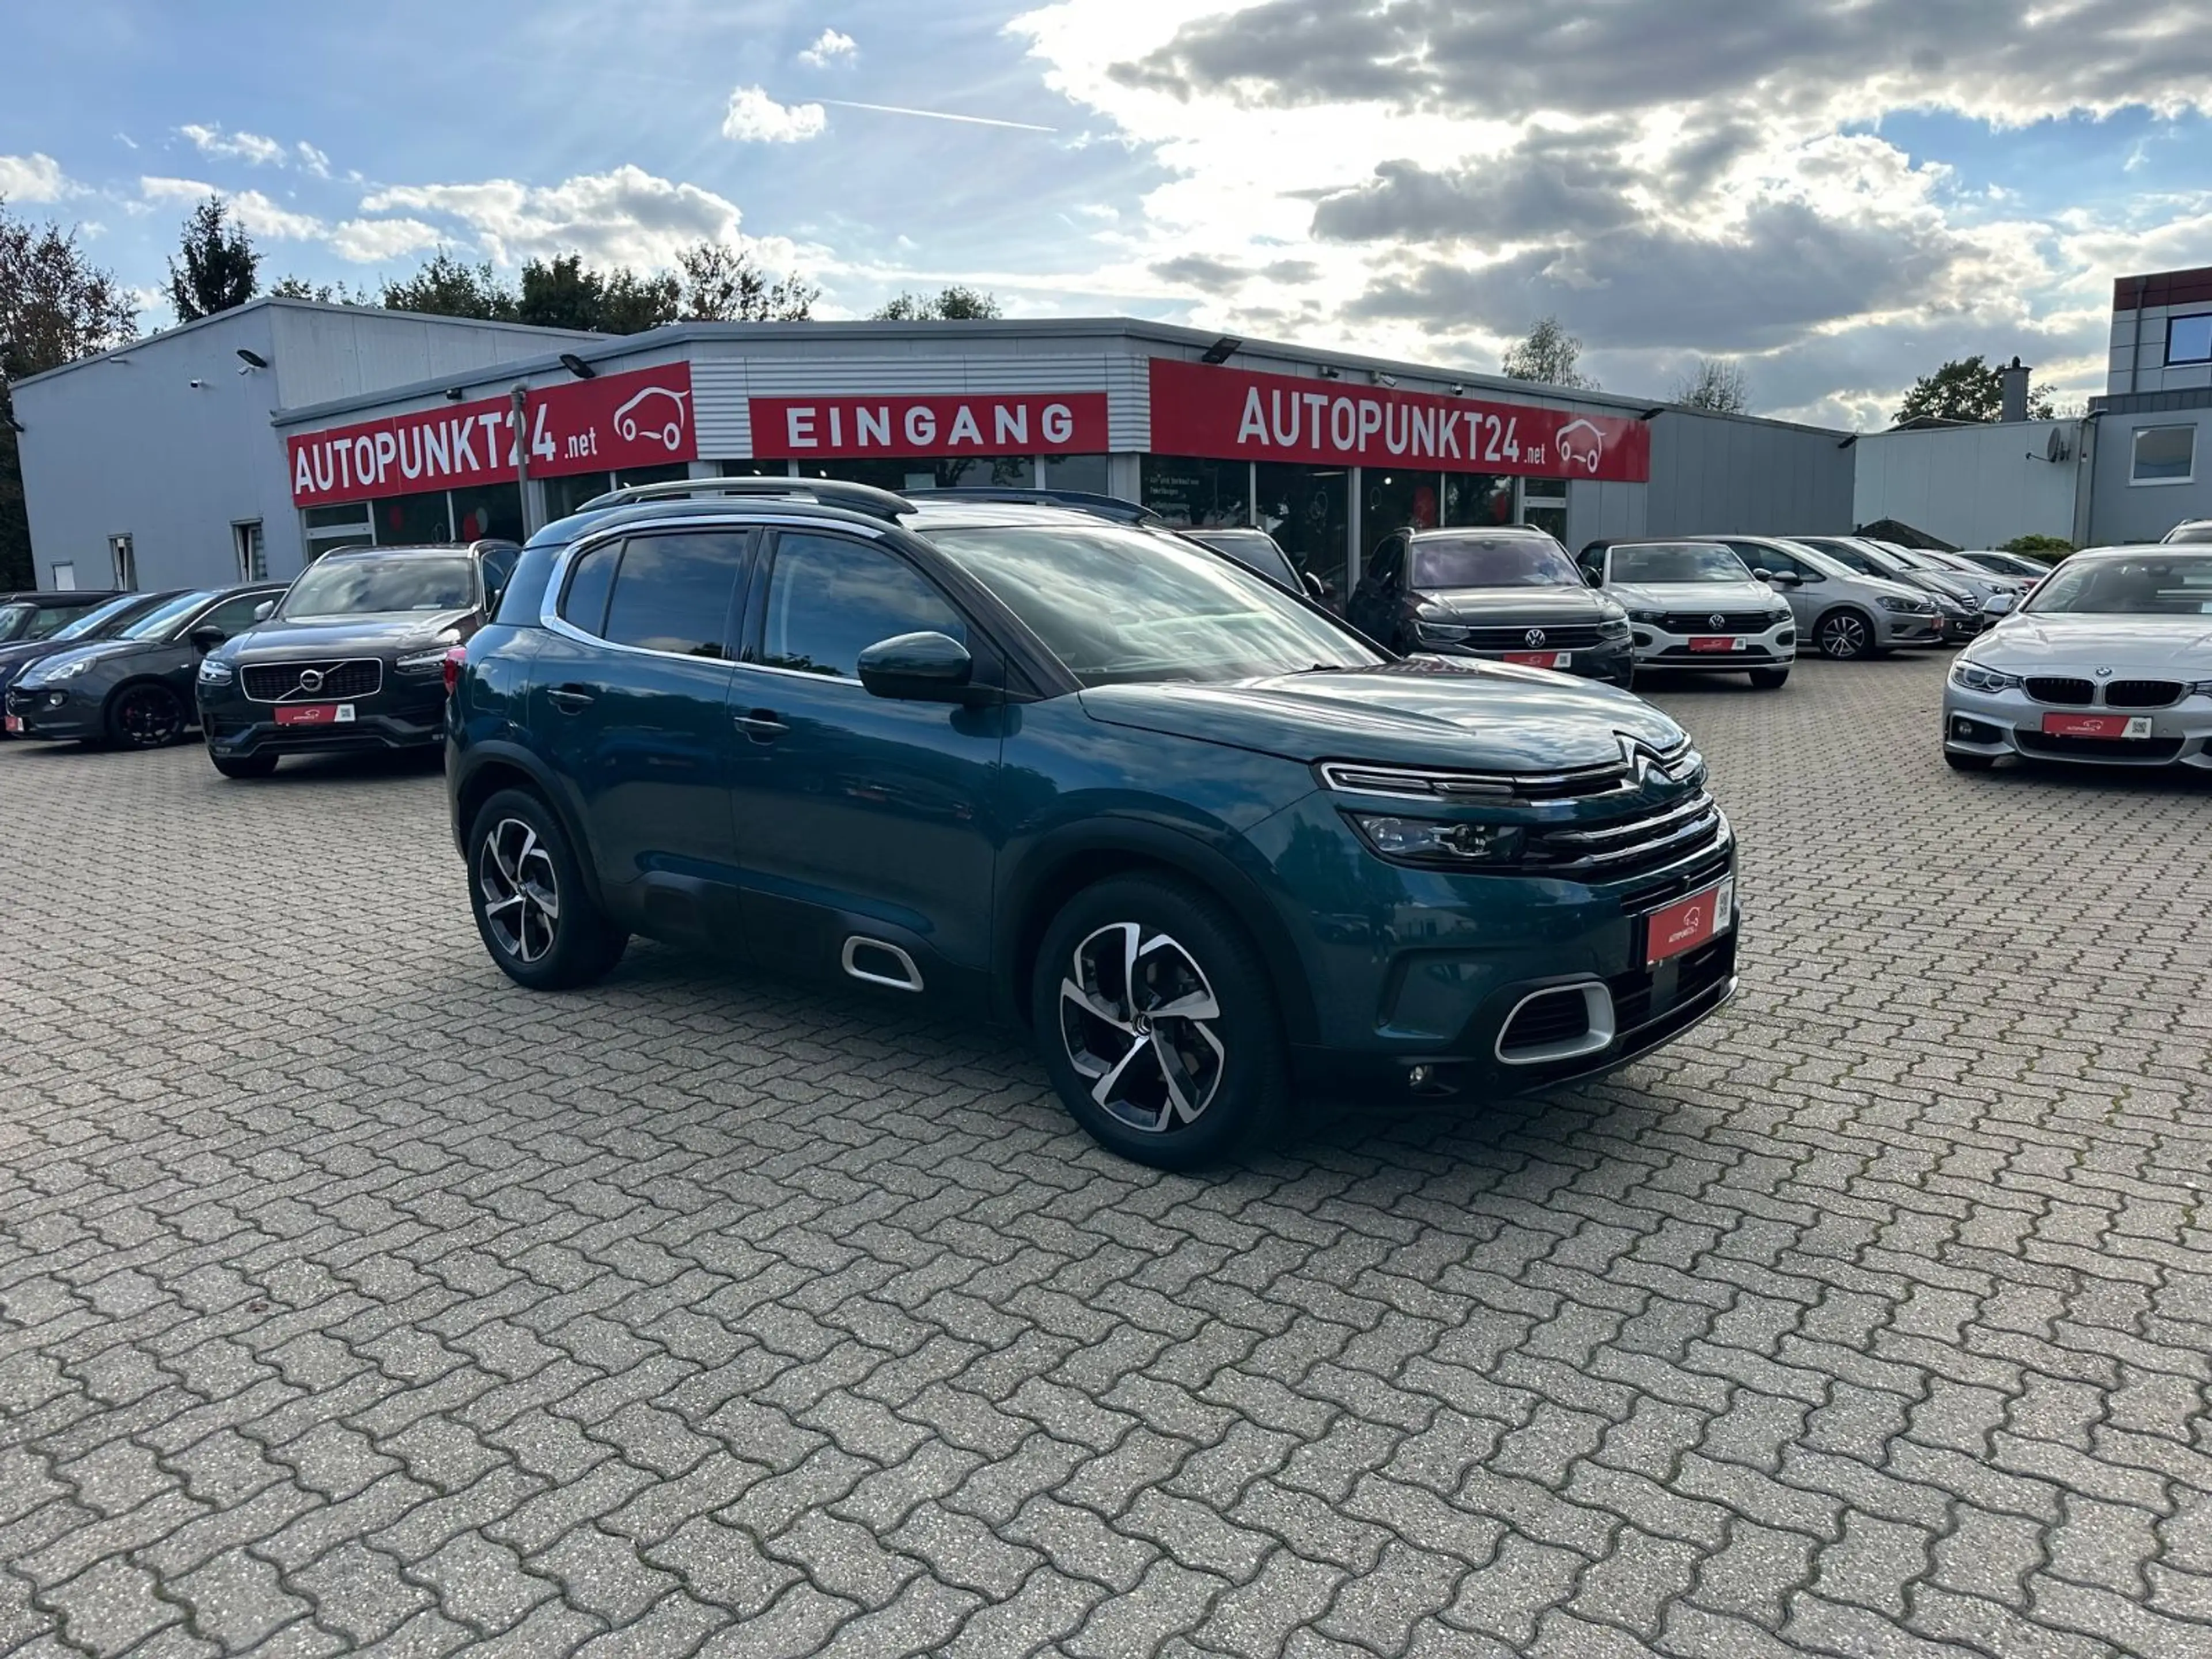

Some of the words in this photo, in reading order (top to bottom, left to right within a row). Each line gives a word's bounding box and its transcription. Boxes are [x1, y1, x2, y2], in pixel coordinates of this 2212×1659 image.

[295, 403, 556, 495] AUTOPUNKT24
[565, 426, 597, 459] .net
[786, 403, 1073, 448] EINGANG
[1237, 387, 1519, 463] AUTOPUNKT24
[1524, 442, 1546, 464] .net
